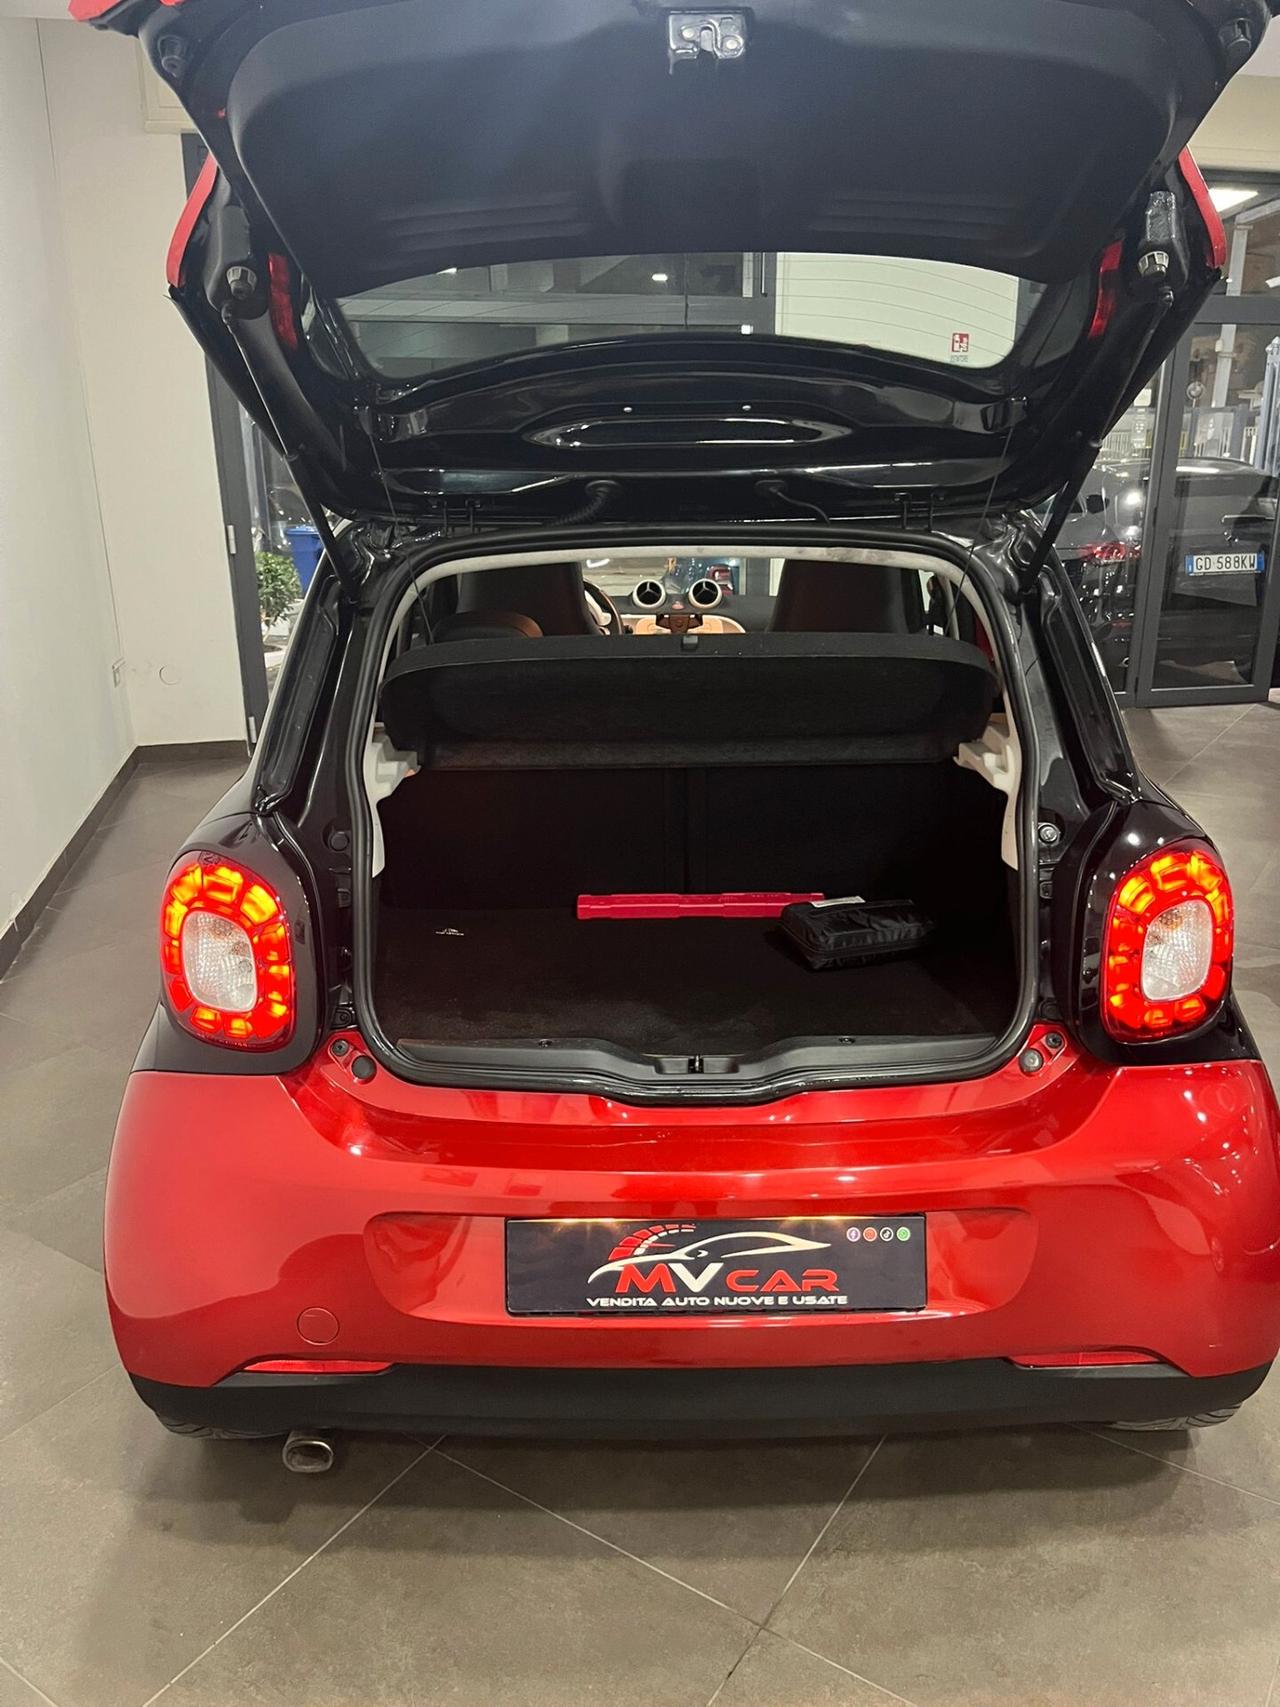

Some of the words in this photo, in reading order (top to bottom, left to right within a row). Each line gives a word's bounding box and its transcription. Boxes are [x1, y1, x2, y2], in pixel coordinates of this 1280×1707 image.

[1195, 556, 1212, 571] GD
[1216, 554, 1256, 570] 588KW
[726, 1268, 840, 1293] CAR
[586, 1297, 658, 1307] VENDITA
[661, 1297, 711, 1307] AUTO
[713, 1296, 775, 1306] NUOVE
[778, 1296, 789, 1305] E
[792, 1295, 848, 1305] USATE
